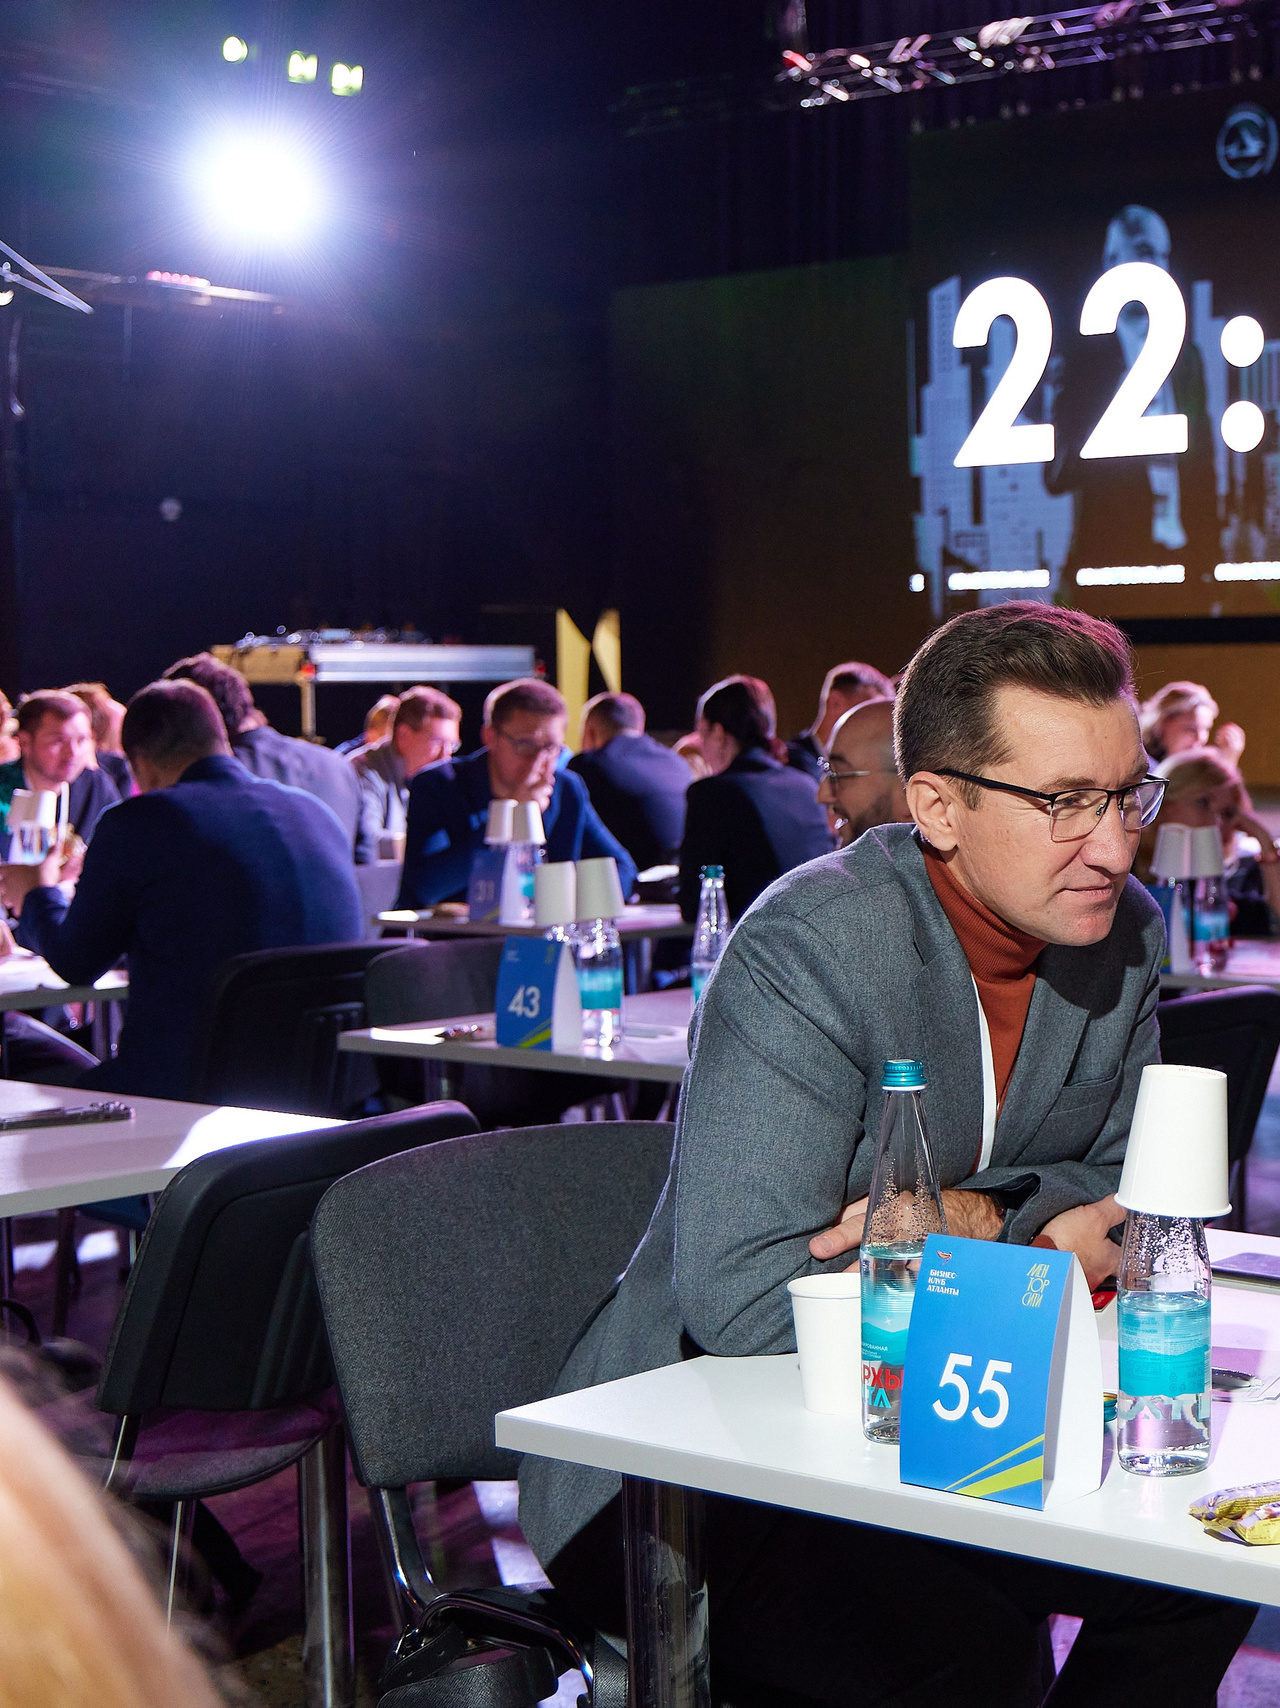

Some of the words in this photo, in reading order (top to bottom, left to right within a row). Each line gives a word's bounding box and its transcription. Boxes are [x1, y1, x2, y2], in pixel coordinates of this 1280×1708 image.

[508, 985, 541, 1018] 43
[926, 1284, 960, 1296] АТЛАНТЫ
[928, 1277, 946, 1286] КЛУБ
[932, 1353, 1012, 1428] 55
